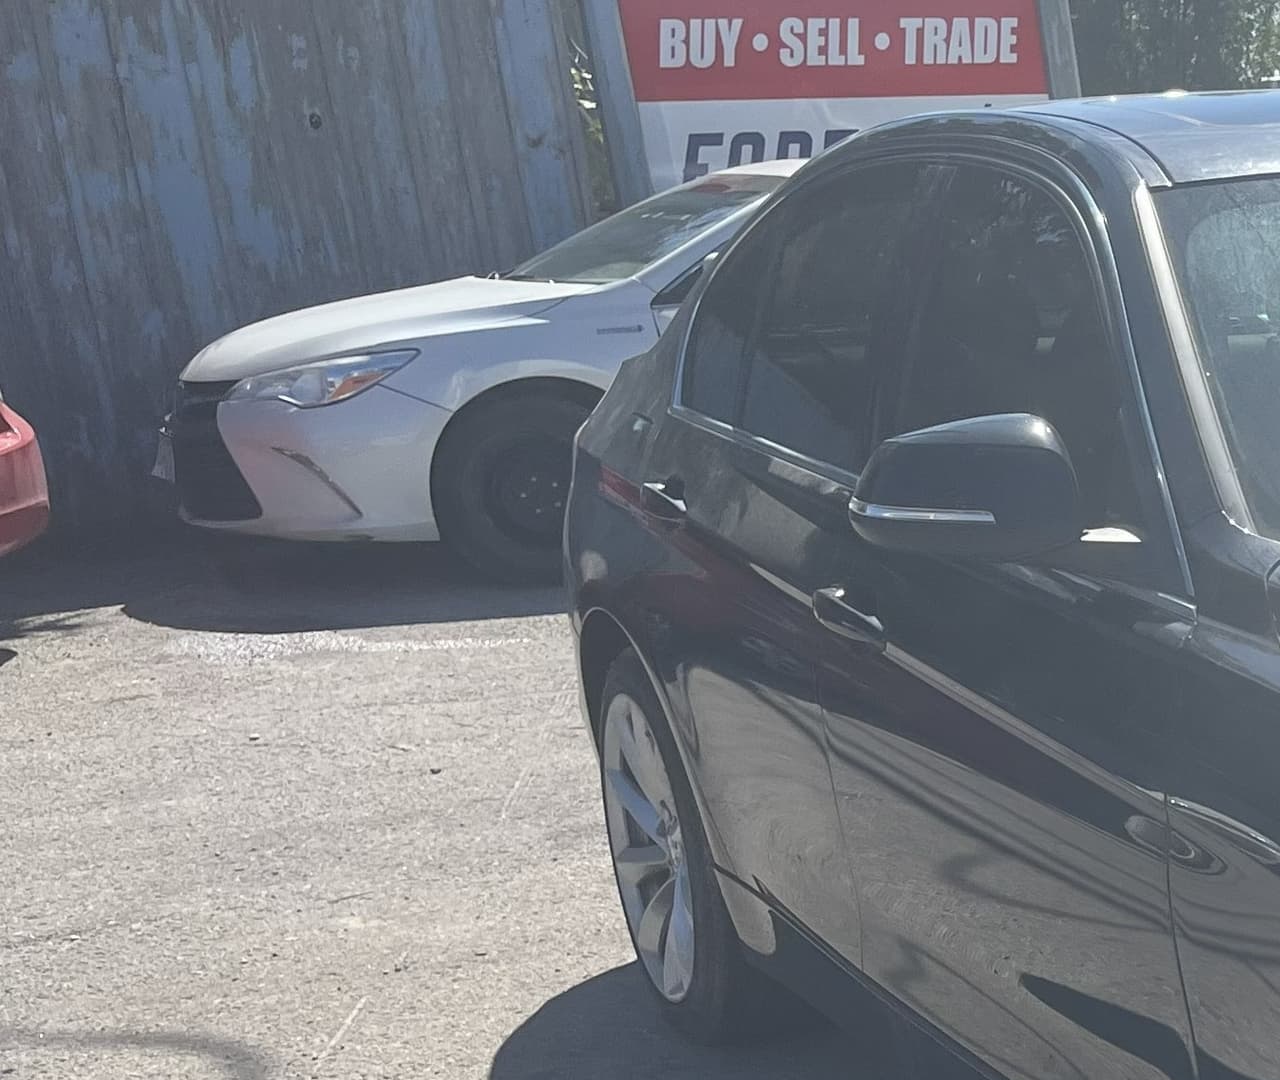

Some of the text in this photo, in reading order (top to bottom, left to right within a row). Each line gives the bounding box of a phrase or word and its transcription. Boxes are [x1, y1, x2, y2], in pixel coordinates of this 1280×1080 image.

[659, 17, 1018, 68] BUY SELL TRADE
